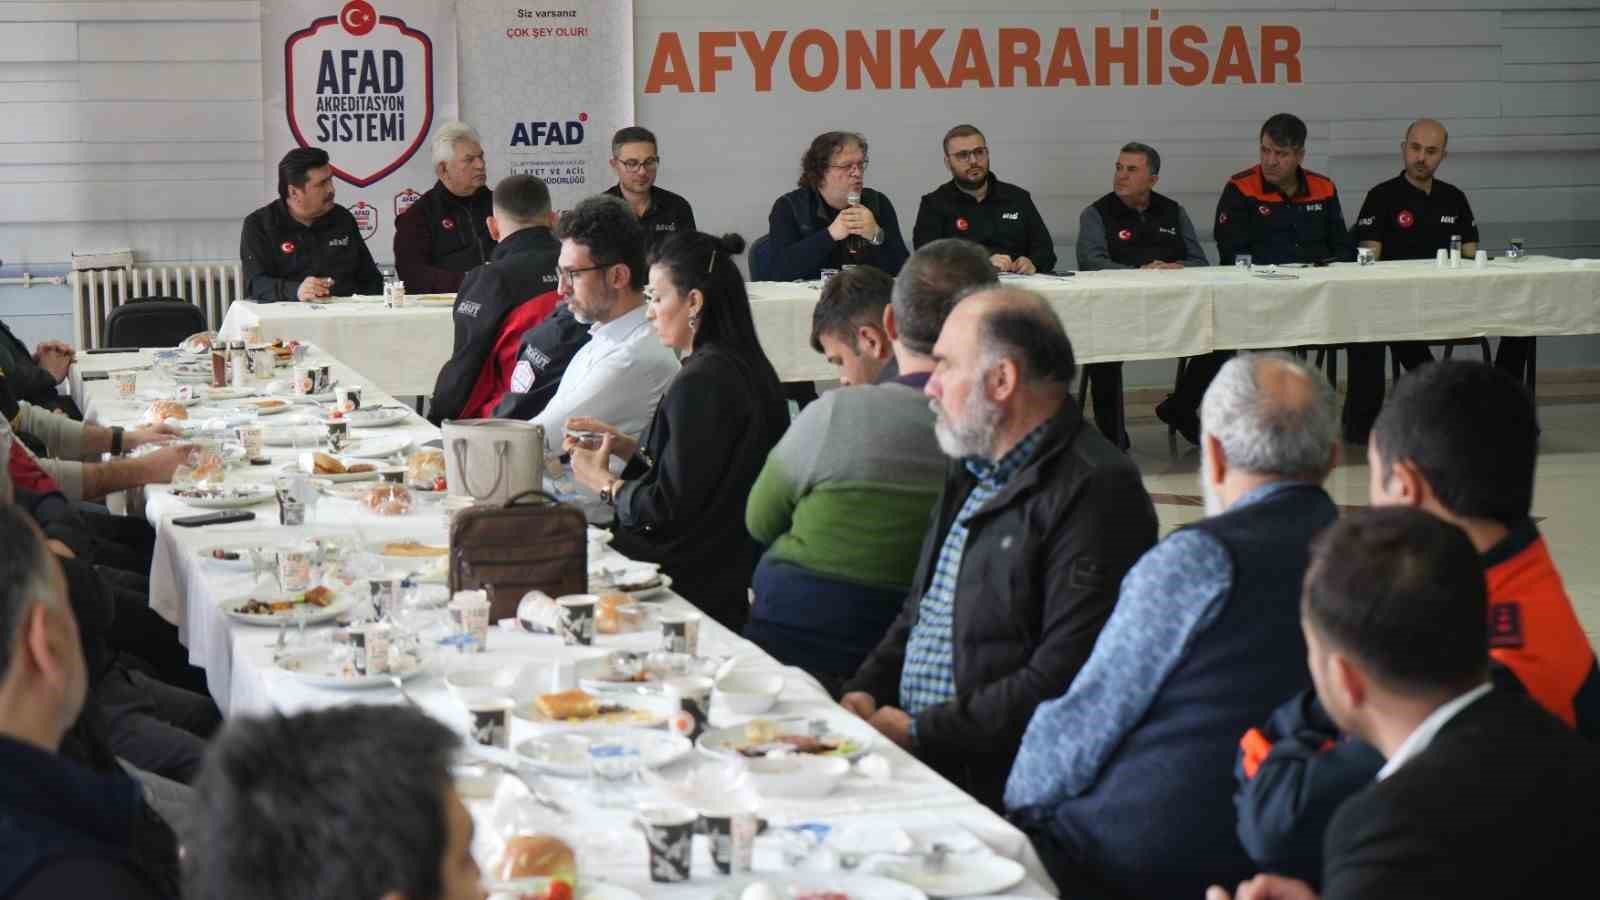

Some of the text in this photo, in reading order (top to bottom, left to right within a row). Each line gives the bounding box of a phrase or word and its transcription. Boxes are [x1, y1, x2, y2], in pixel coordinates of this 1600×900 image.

[517, 8, 577, 18] Siz varsanız
[506, 27, 588, 38] ÇOK ŞEY OLUR!
[644, 9, 1303, 93] AFYONKARAHİSAR
[316, 50, 404, 94] AFAD
[316, 96, 404, 112] AKREDİTASYON
[316, 113, 405, 142] SİSTEMİ
[510, 121, 584, 146] AFAD
